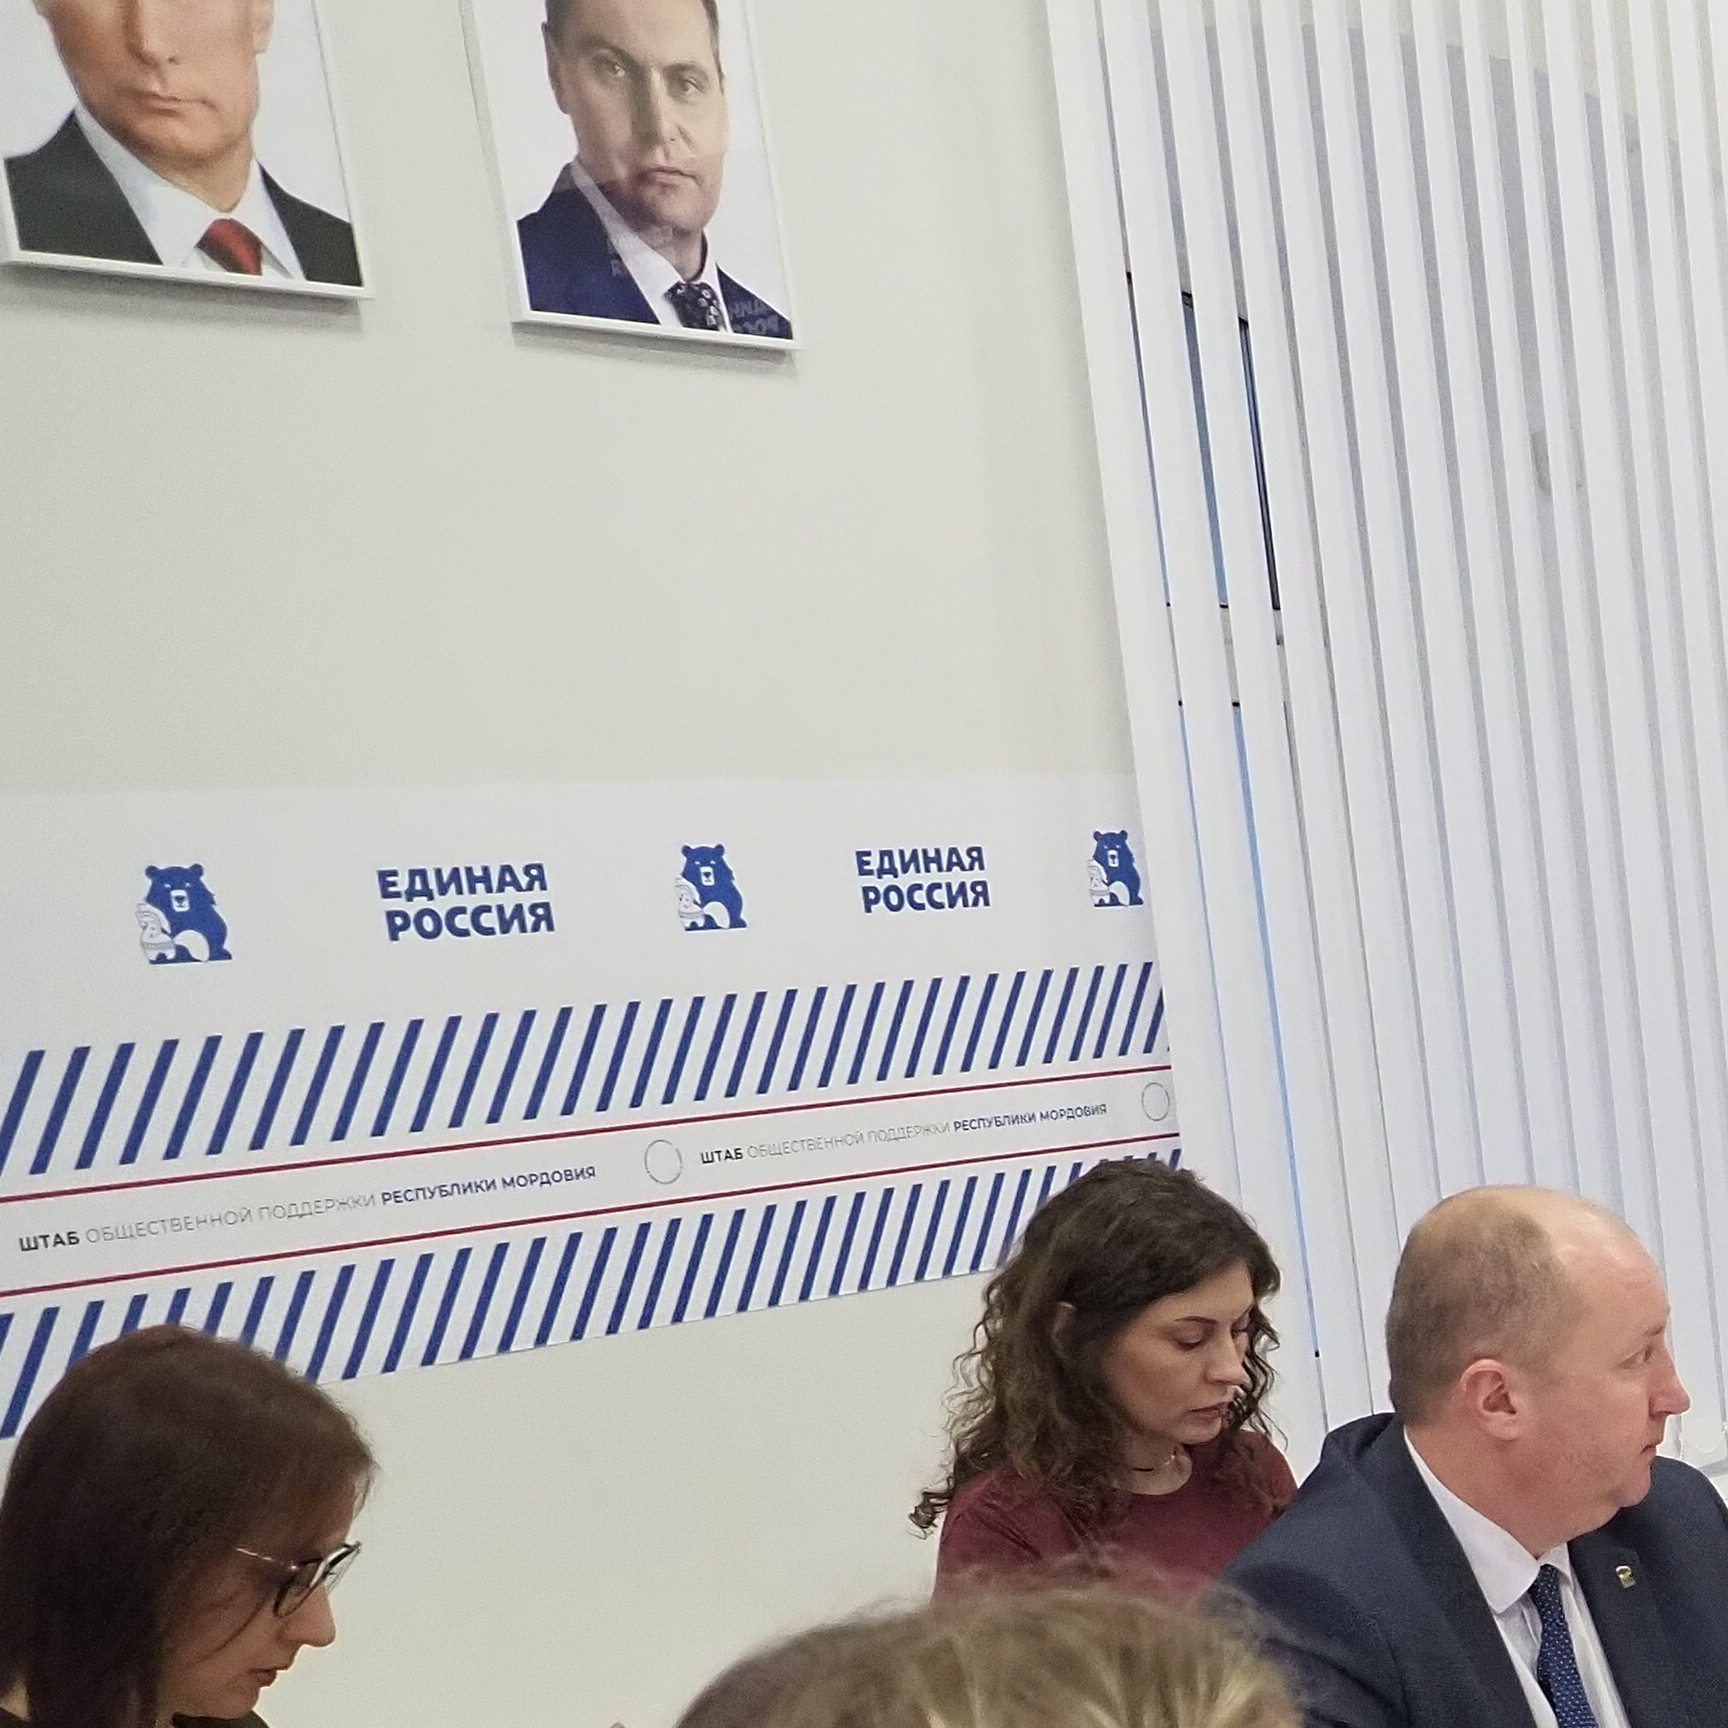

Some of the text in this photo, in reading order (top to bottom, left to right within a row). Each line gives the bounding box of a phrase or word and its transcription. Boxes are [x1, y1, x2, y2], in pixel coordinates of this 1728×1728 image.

[855, 846, 985, 879] ЕДИНАЯ
[377, 863, 548, 902] ЕДИНАЯ
[861, 880, 990, 913] РОССИЯ
[386, 902, 555, 941] РОССИЯ
[700, 1147, 743, 1164] ШТАБ
[953, 1112, 1036, 1132] РЕСПУБЛИКИ
[1040, 1103, 1108, 1122] МОРДОВИЯ
[19, 1166, 596, 1252] ШТАБ ОБЩЕСТВЕННОЙ ПОДДЕРЖКИ РЕСПУБЛИКИ МОРДОВИЯ
